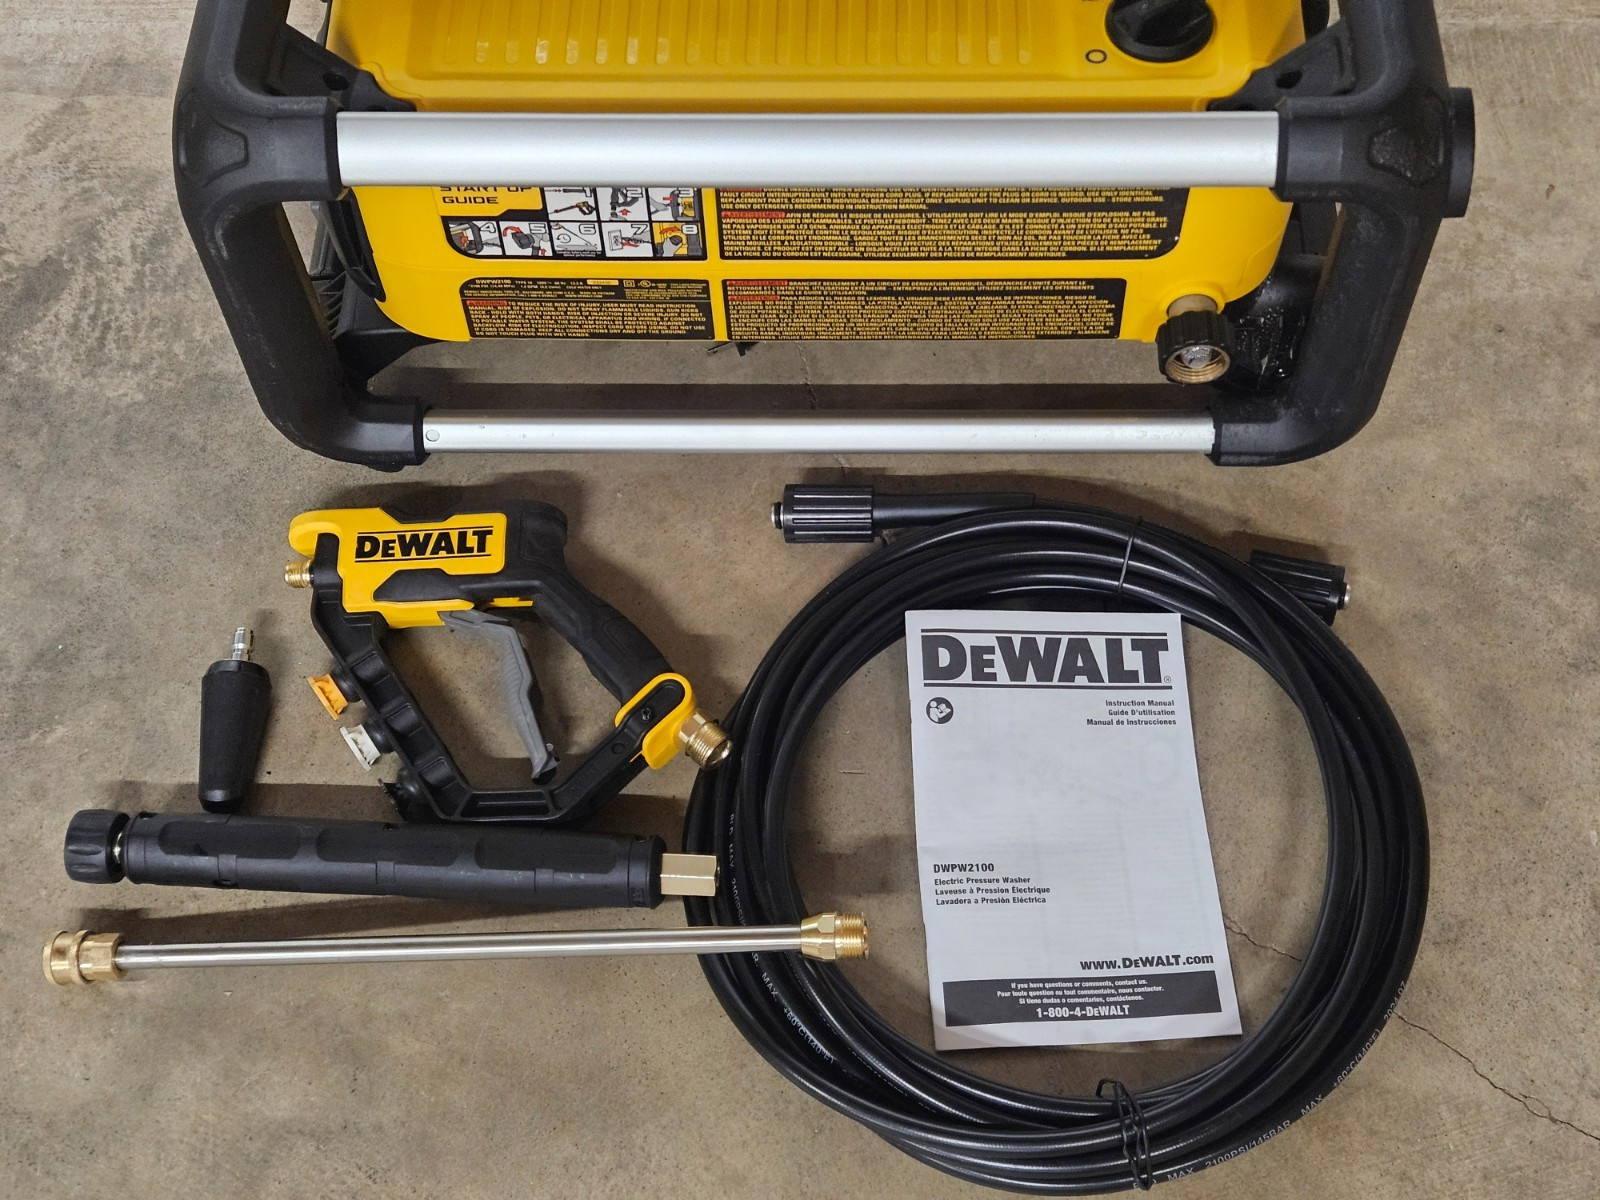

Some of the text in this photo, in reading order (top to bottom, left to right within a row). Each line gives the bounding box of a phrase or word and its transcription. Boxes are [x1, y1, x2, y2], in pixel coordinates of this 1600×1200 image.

[933, 863, 994, 873] DWPW2100
[1012, 885, 1050, 894] Électrique
[1167, 1167, 1194, 1181] MAX
[1300, 1094, 1323, 1116] MAX
